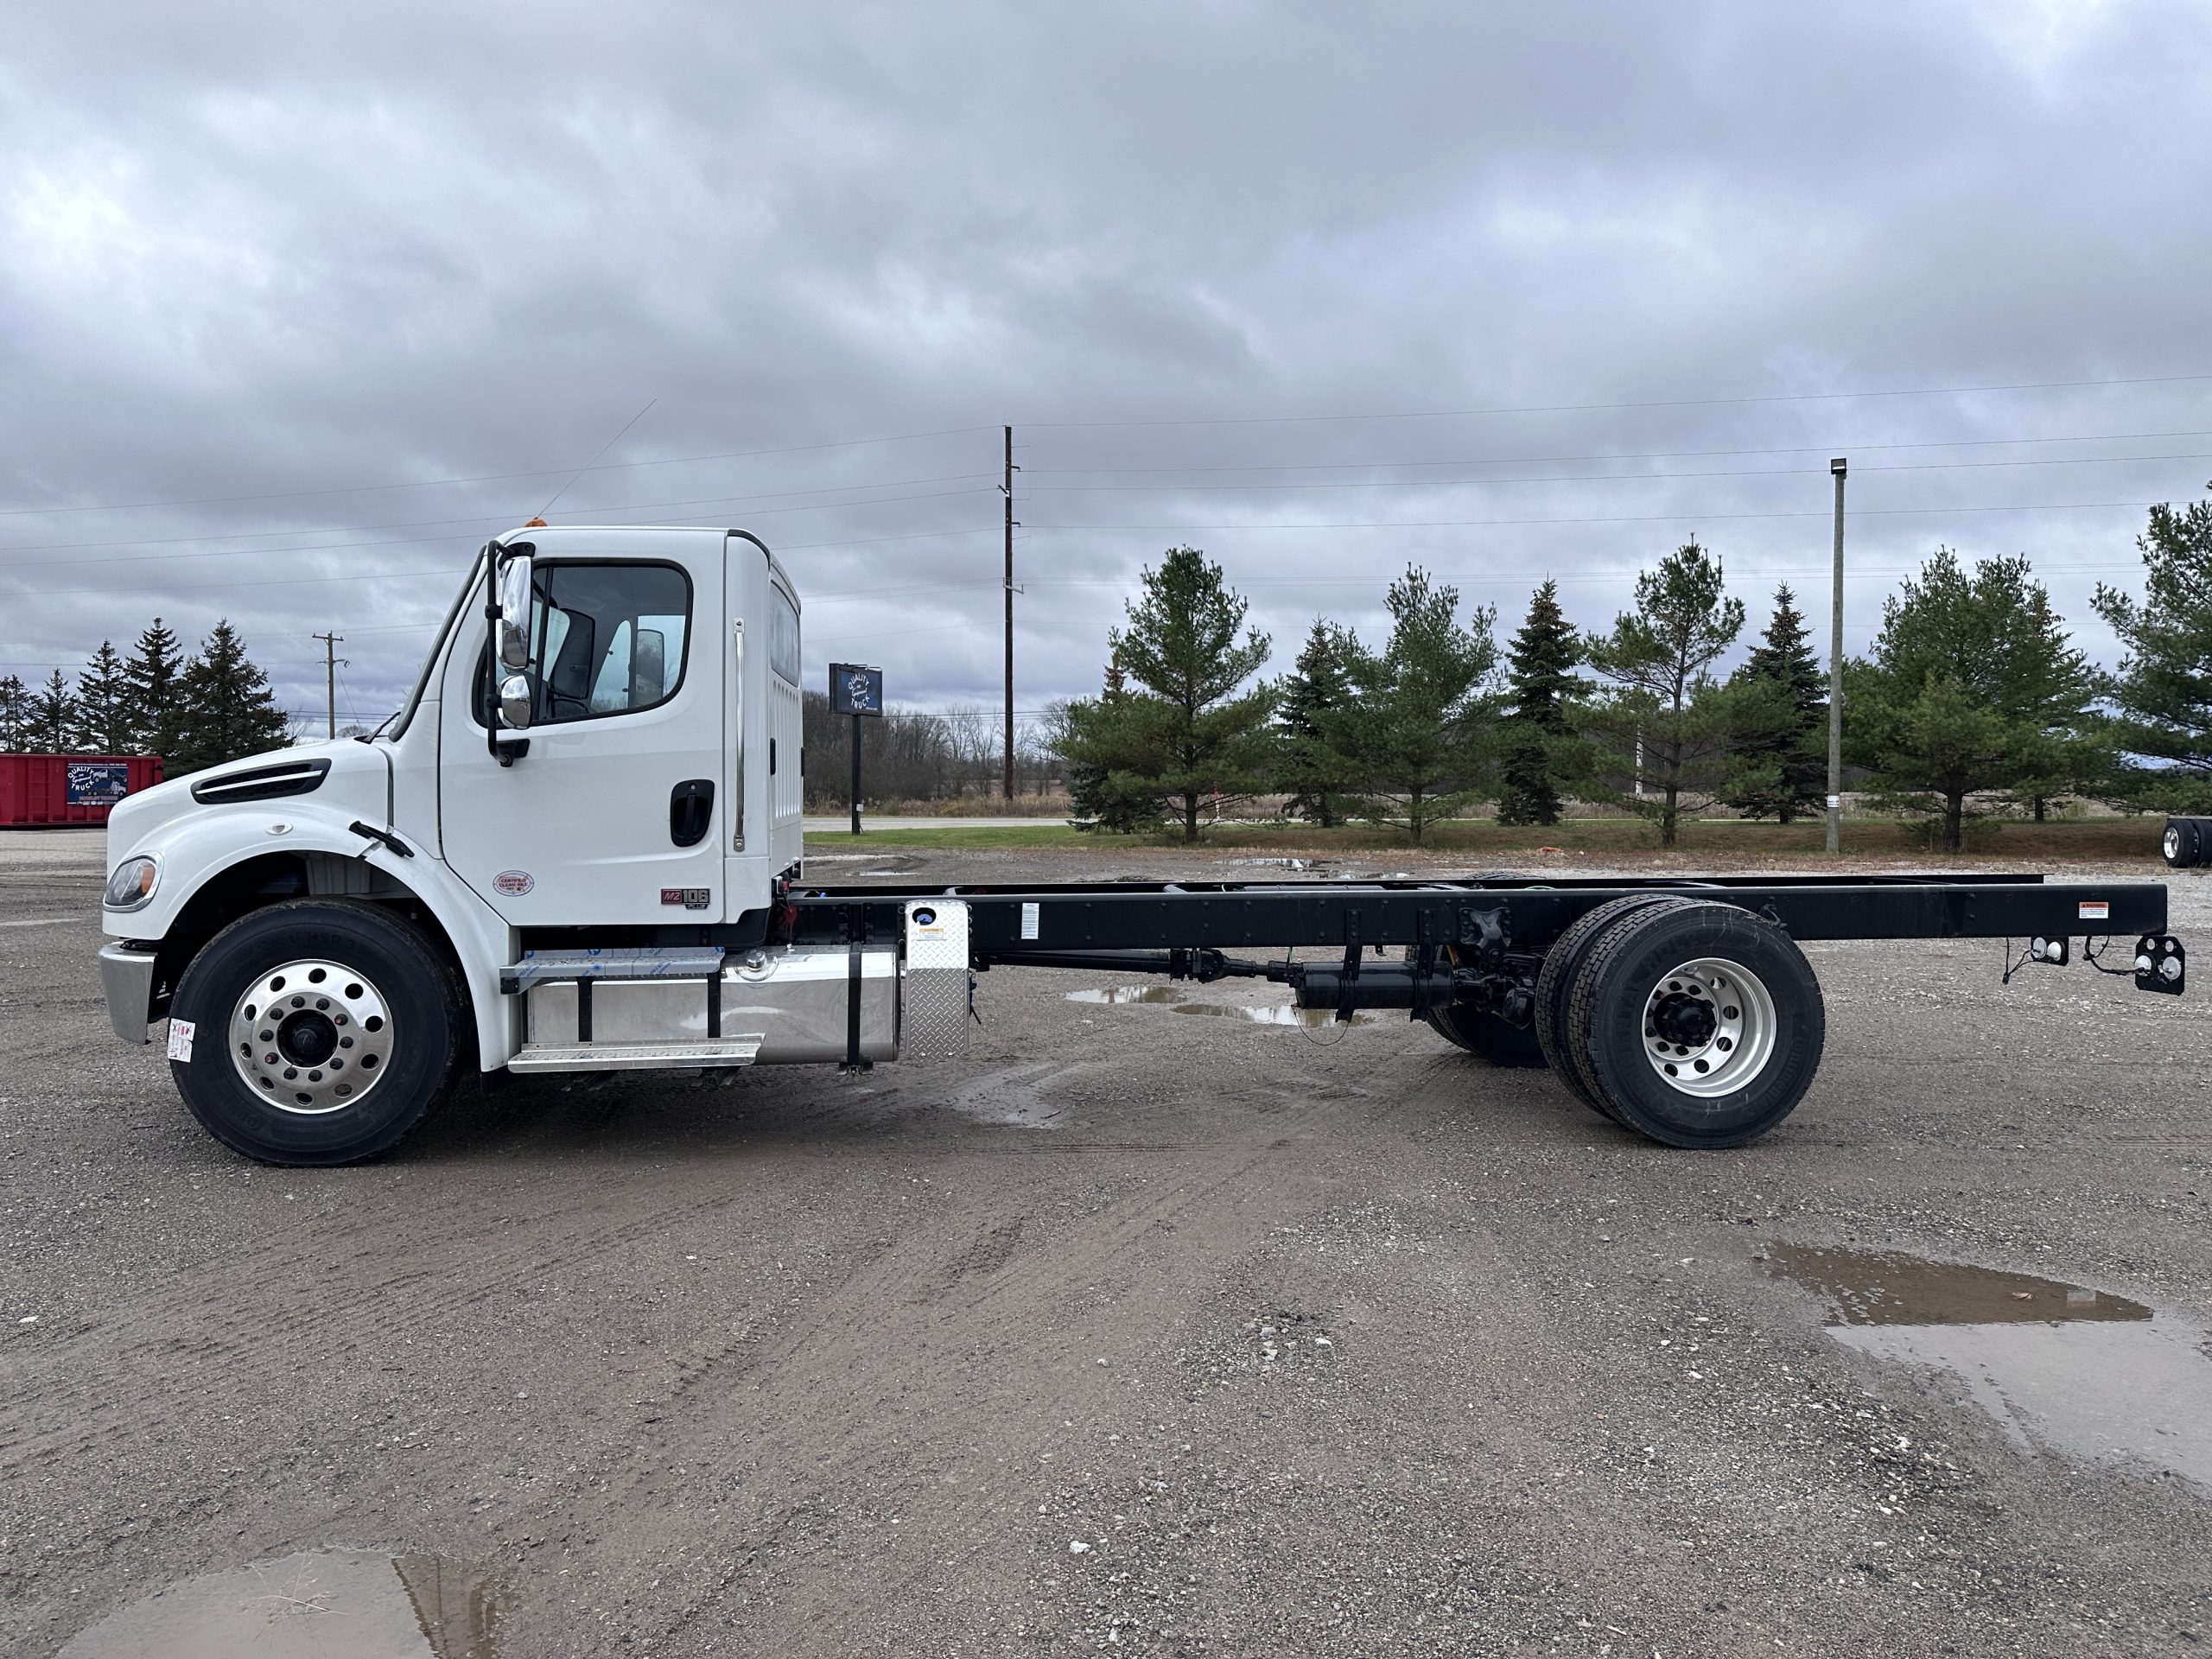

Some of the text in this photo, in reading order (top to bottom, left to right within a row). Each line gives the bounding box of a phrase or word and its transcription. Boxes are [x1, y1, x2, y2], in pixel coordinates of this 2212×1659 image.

[849, 674, 869, 690] QUALITY
[851, 693, 870, 709] TRUCK
[68, 766, 94, 778] QUALITY
[72, 780, 94, 791] TRUCK
[664, 890, 709, 903] M2 106
